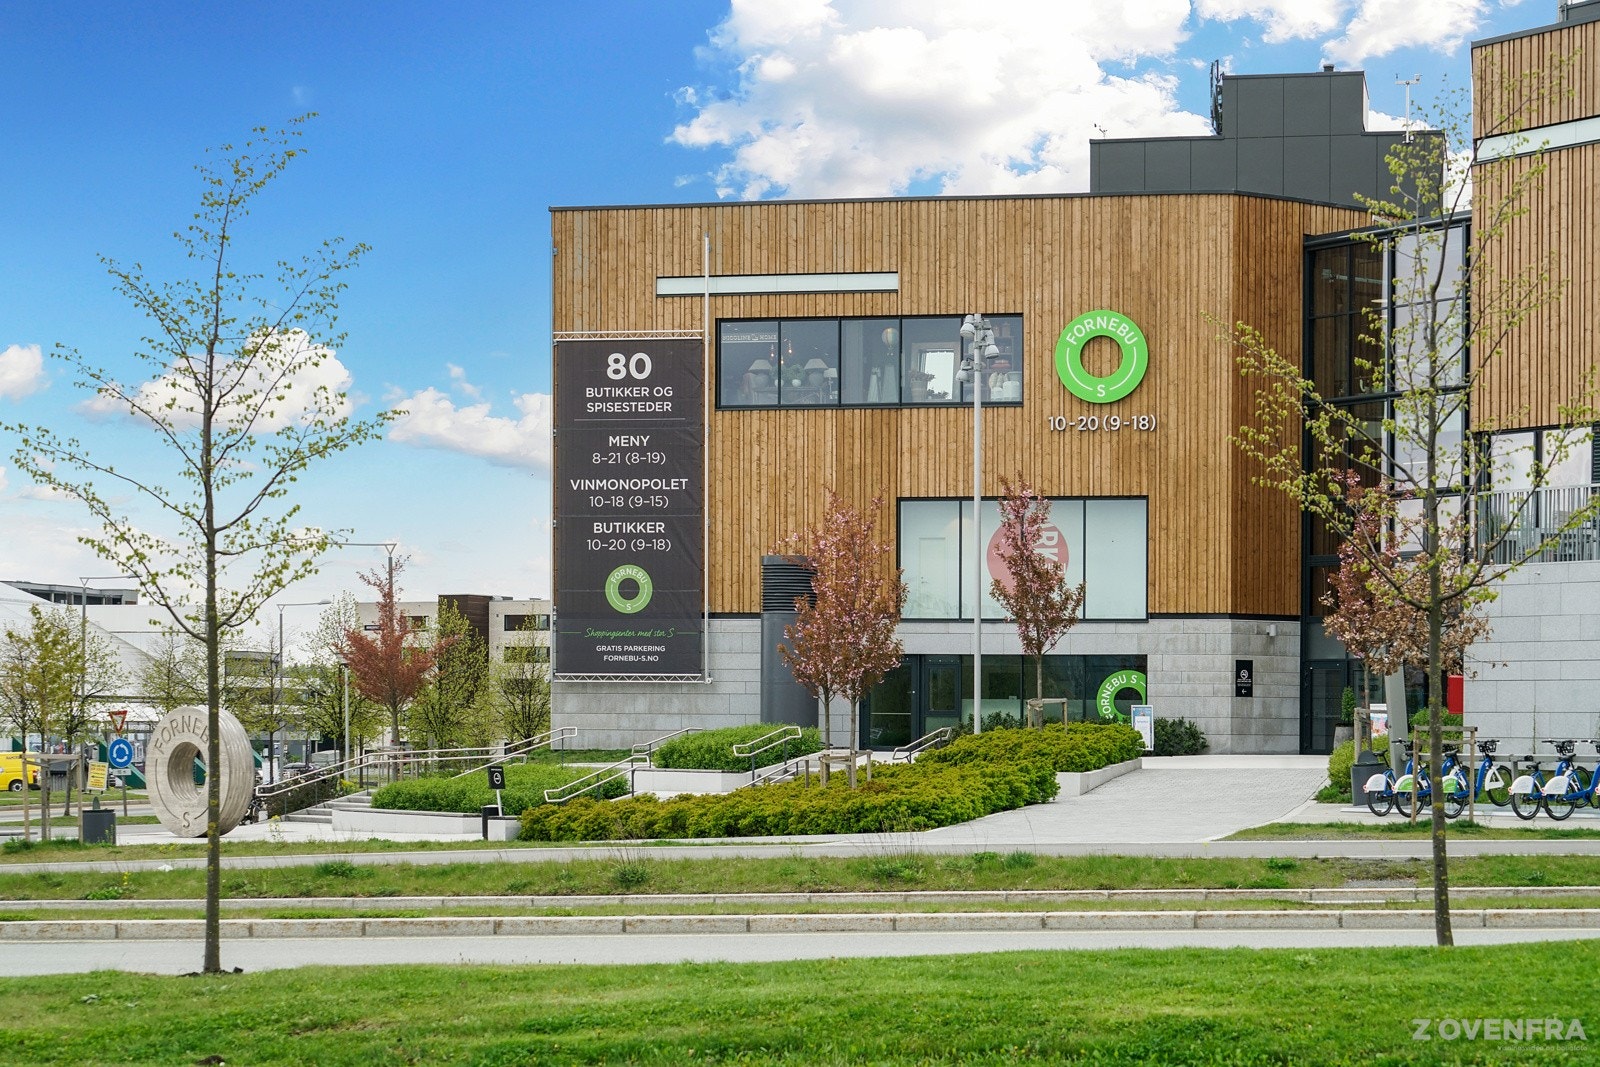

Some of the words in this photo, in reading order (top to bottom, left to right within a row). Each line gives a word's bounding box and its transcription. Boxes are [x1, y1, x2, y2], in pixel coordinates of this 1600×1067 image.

[1066, 316, 1138, 345] FORNEBU
[606, 352, 652, 380] 80
[586, 387, 649, 398] BUTIKKER
[653, 386, 673, 397] OG
[1096, 384, 1106, 397] S
[586, 402, 672, 413] SPISESTEDER
[608, 435, 650, 447] MENY
[592, 452, 621, 464] 8-21
[625, 452, 666, 465] (8-19)
[570, 478, 688, 491] VINMONOPOLET
[589, 495, 624, 507] 10-18
[628, 495, 669, 508] (9-15)
[593, 522, 665, 534] BUTIKKER
[587, 538, 626, 551] 10-20
[631, 538, 671, 552] (9-18)
[610, 568, 647, 584] FORNEBU
[626, 603, 632, 611] S
[637, 628, 653, 638] med
[654, 629, 666, 637] stor
[667, 627, 675, 638] S
[1130, 675, 1138, 684] S
[154, 715, 209, 755] FORNEB
[182, 811, 191, 829] S
